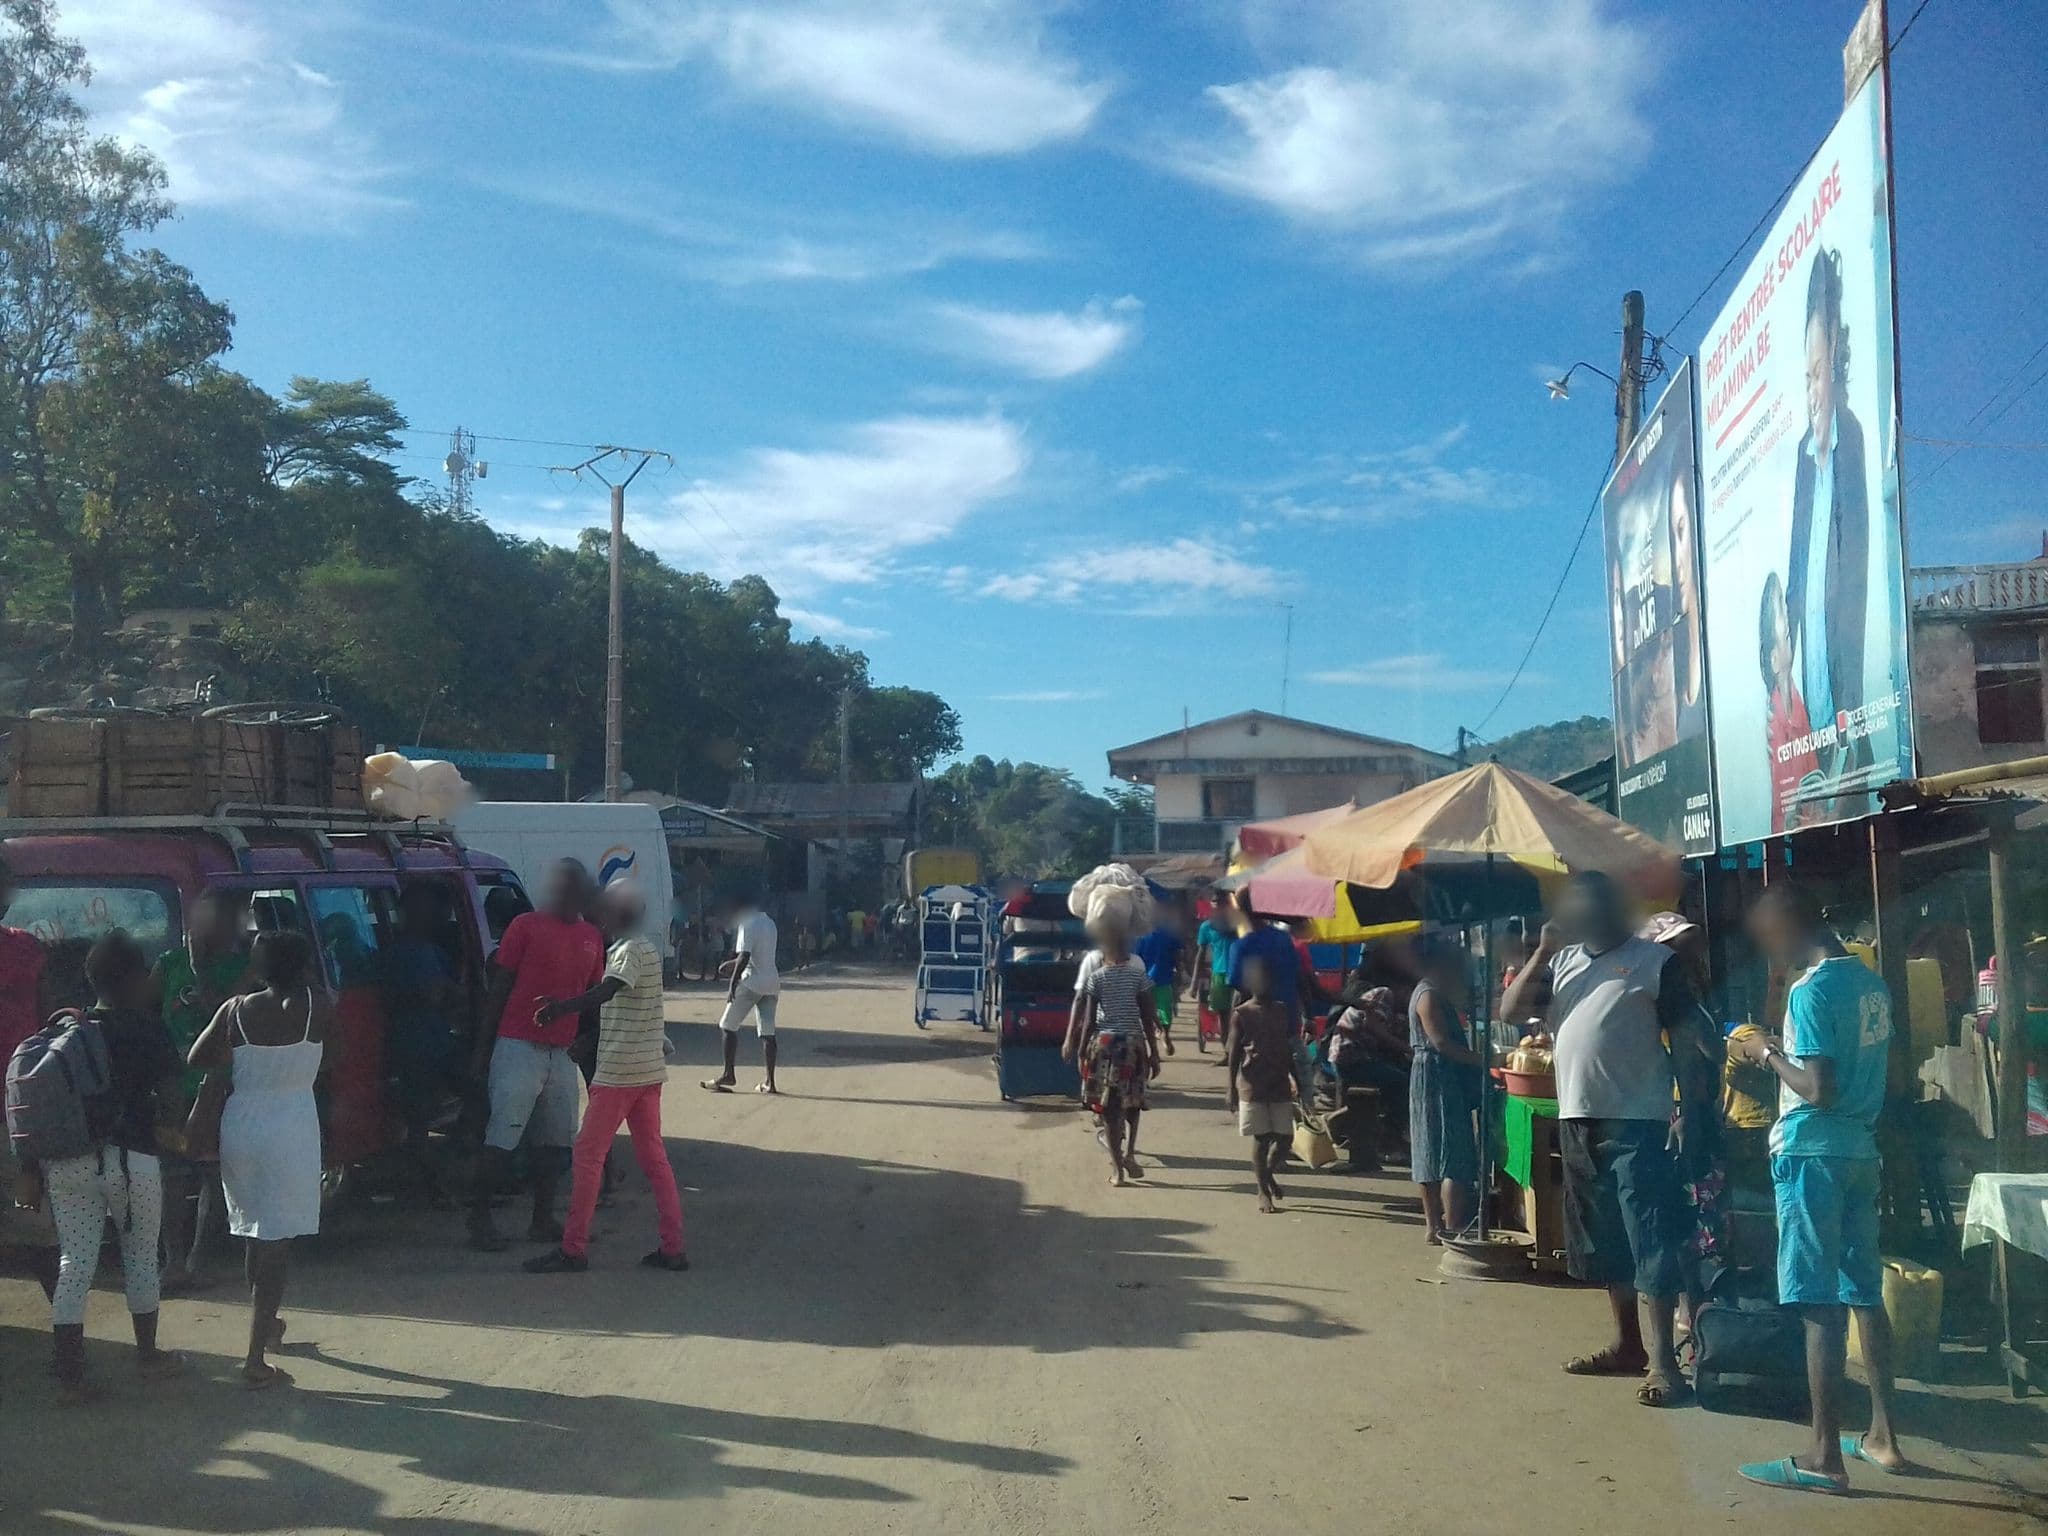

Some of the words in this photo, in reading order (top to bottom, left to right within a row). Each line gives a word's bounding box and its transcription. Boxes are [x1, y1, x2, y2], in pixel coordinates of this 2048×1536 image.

[1706, 332, 1729, 390] PRÊT
[1730, 261, 1775, 355] RENTRÉE
[1777, 158, 1842, 284] SCOLAIRE
[1706, 345, 1755, 432] MILAMINA
[1757, 319, 1771, 366] BE
[1638, 595, 1657, 644] MUR
[1792, 734, 1810, 758] VOUS
[1808, 723, 1839, 753] L'AVENIR
[1683, 811, 1711, 842] CANAL+
